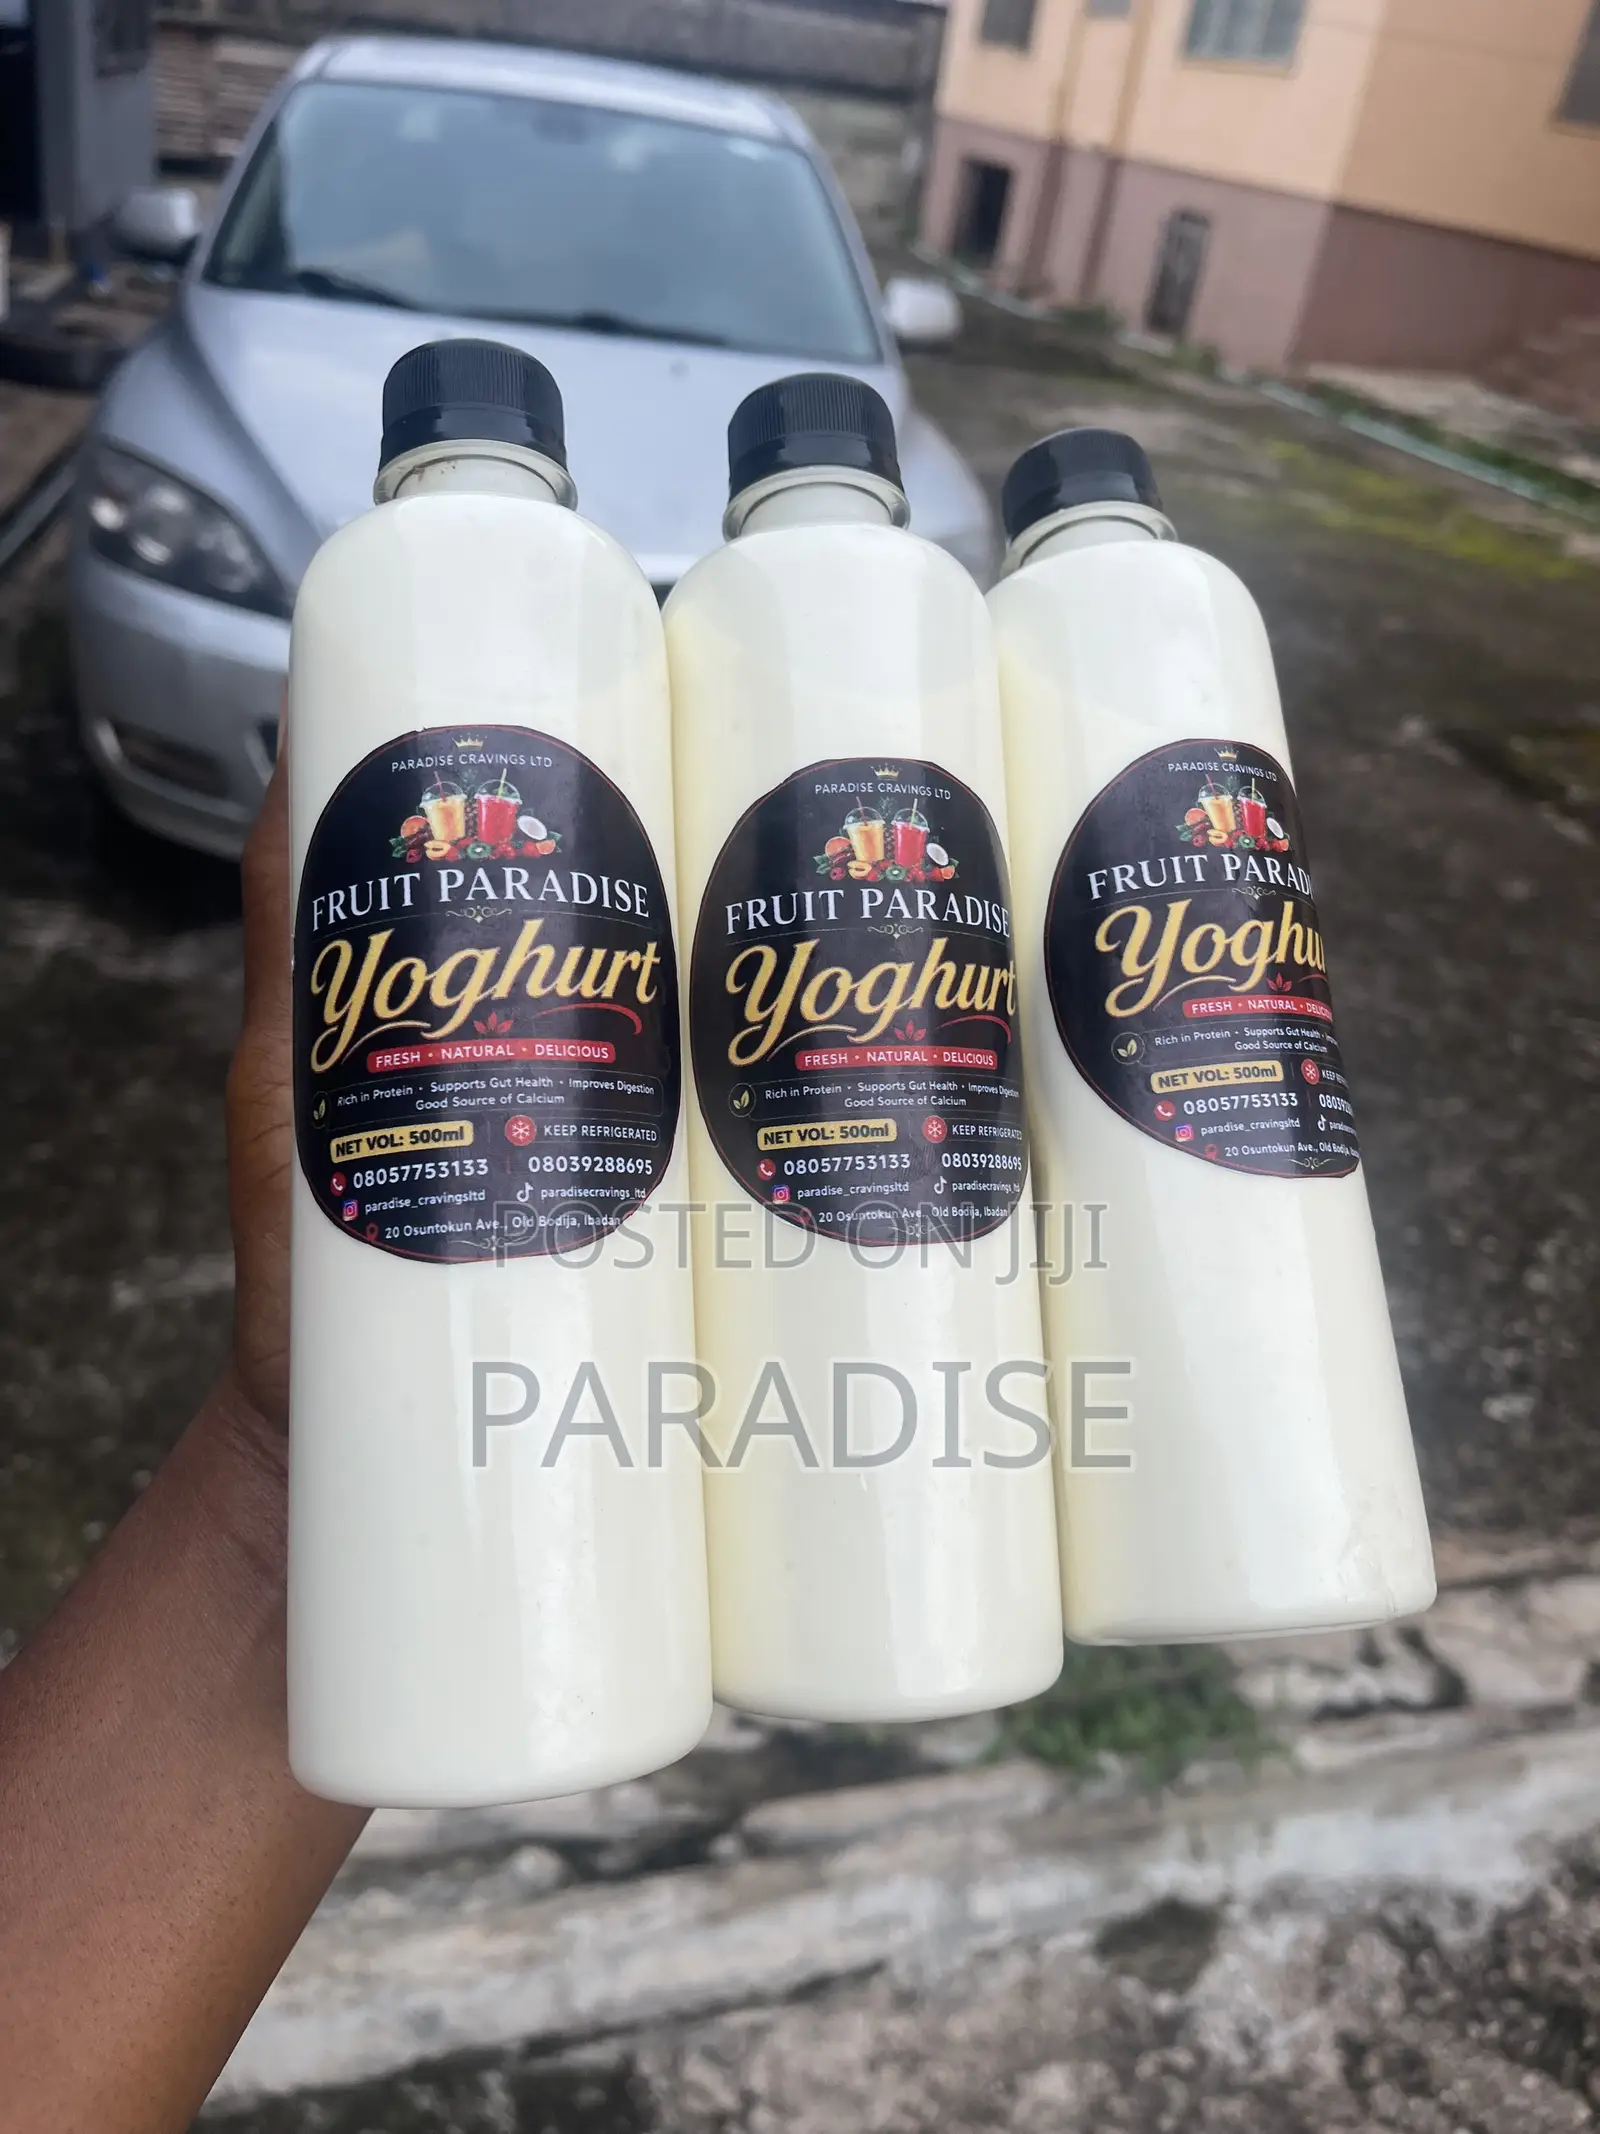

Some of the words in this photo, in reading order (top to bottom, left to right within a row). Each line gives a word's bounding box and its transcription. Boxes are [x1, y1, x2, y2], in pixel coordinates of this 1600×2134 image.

[392, 755, 454, 772] PARADISE
[459, 754, 526, 767] CRAVINGS
[530, 756, 552, 768] LTD
[1168, 761, 1219, 772] PARADISE
[1222, 763, 1264, 781] CRAVINGS
[1265, 771, 1277, 782] LTD
[815, 783, 874, 794] PARADISE
[878, 783, 931, 797] CRAVINGS
[935, 789, 951, 800] LTD
[1087, 855, 1208, 900] FRUIT
[312, 873, 420, 932] FRUIT
[438, 866, 650, 918] PARADISE
[725, 889, 844, 935] FRUIT
[860, 888, 1010, 937] PARADISE
[311, 918, 660, 1072] Yoghurt
[725, 937, 1016, 1066] Yoghurt
[1192, 1002, 1232, 1014] FRESH
[1248, 999, 1297, 1011] NATURAL
[1155, 1036, 1178, 1045] Rich
[1181, 1034, 1191, 1043] in
[1194, 1029, 1230, 1040] Protein
[1244, 1027, 1284, 1038] Supports
[1286, 1026, 1300, 1036] Gut
[1235, 1041, 1260, 1051] Good
[1263, 1040, 1292, 1050] Source
[1294, 1040, 1302, 1049] of
[376, 1052, 421, 1068] FRESH
[441, 1045, 514, 1060] NATURAL
[535, 1044, 609, 1059] DELICIOUS
[804, 1053, 848, 1066] FRESH
[867, 1050, 928, 1063] NATURAL
[943, 1051, 994, 1066] DELICIOUS
[1158, 1073, 1188, 1089] NET
[1193, 1069, 1230, 1083] VOL:
[1234, 1065, 1276, 1079] 500ml
[337, 1094, 358, 1106] Rich
[360, 1091, 370, 1102] in
[373, 1086, 413, 1099] Protein
[430, 1079, 486, 1094] Supports
[489, 1077, 512, 1089] Gut
[516, 1076, 553, 1088] Health
[569, 1078, 613, 1091] Improves
[617, 1080, 654, 1095] Digestion
[765, 1089, 787, 1099] Rich
[790, 1088, 800, 1097] in
[803, 1084, 842, 1096] Protein
[858, 1081, 906, 1094] Supports
[909, 1080, 926, 1091] Gut
[929, 1081, 958, 1091] Health
[968, 1083, 997, 1094] Improves
[416, 1099, 448, 1110] Good
[452, 1095, 495, 1107] Source
[499, 1094, 513, 1104] of
[516, 1093, 564, 1105] Calcium
[844, 1097, 875, 1108] Good
[877, 1096, 914, 1106] Source
[917, 1094, 927, 1105] of
[930, 1097, 966, 1106] Calcium
[1184, 1093, 1298, 1114] 08057753133
[544, 1125, 577, 1137] KEEP
[582, 1125, 657, 1142] REFRIGERATED
[763, 1131, 795, 1145] NET
[799, 1128, 835, 1141] VOL:
[840, 1124, 889, 1139] 500ml
[952, 1125, 975, 1137] KEEP
[1201, 1118, 1300, 1136] paradise_cravingsltd
[335, 1139, 364, 1157] NET
[368, 1134, 404, 1150] VOL:
[409, 1127, 465, 1145] 500ml
[1225, 1147, 1238, 1157] 20
[1242, 1143, 1296, 1155] Osuntokun
[1319, 1142, 1332, 1152] Old
[529, 1156, 653, 1175] 08039288695
[784, 1153, 911, 1175] 08057753133
[942, 1153, 1022, 1171] 08039288695
[353, 1159, 489, 1189] 08057753133
[798, 1182, 909, 1200] paradise_cravingsltd
[364, 1189, 485, 1214] paradise_cravingsltd
[819, 1211, 833, 1223] 20
[837, 1210, 899, 1221] Osuntokun
[932, 1207, 949, 1218] Old
[385, 1227, 400, 1239] 20
[403, 1222, 472, 1237] Osuntokun
[512, 1215, 534, 1227] Old
